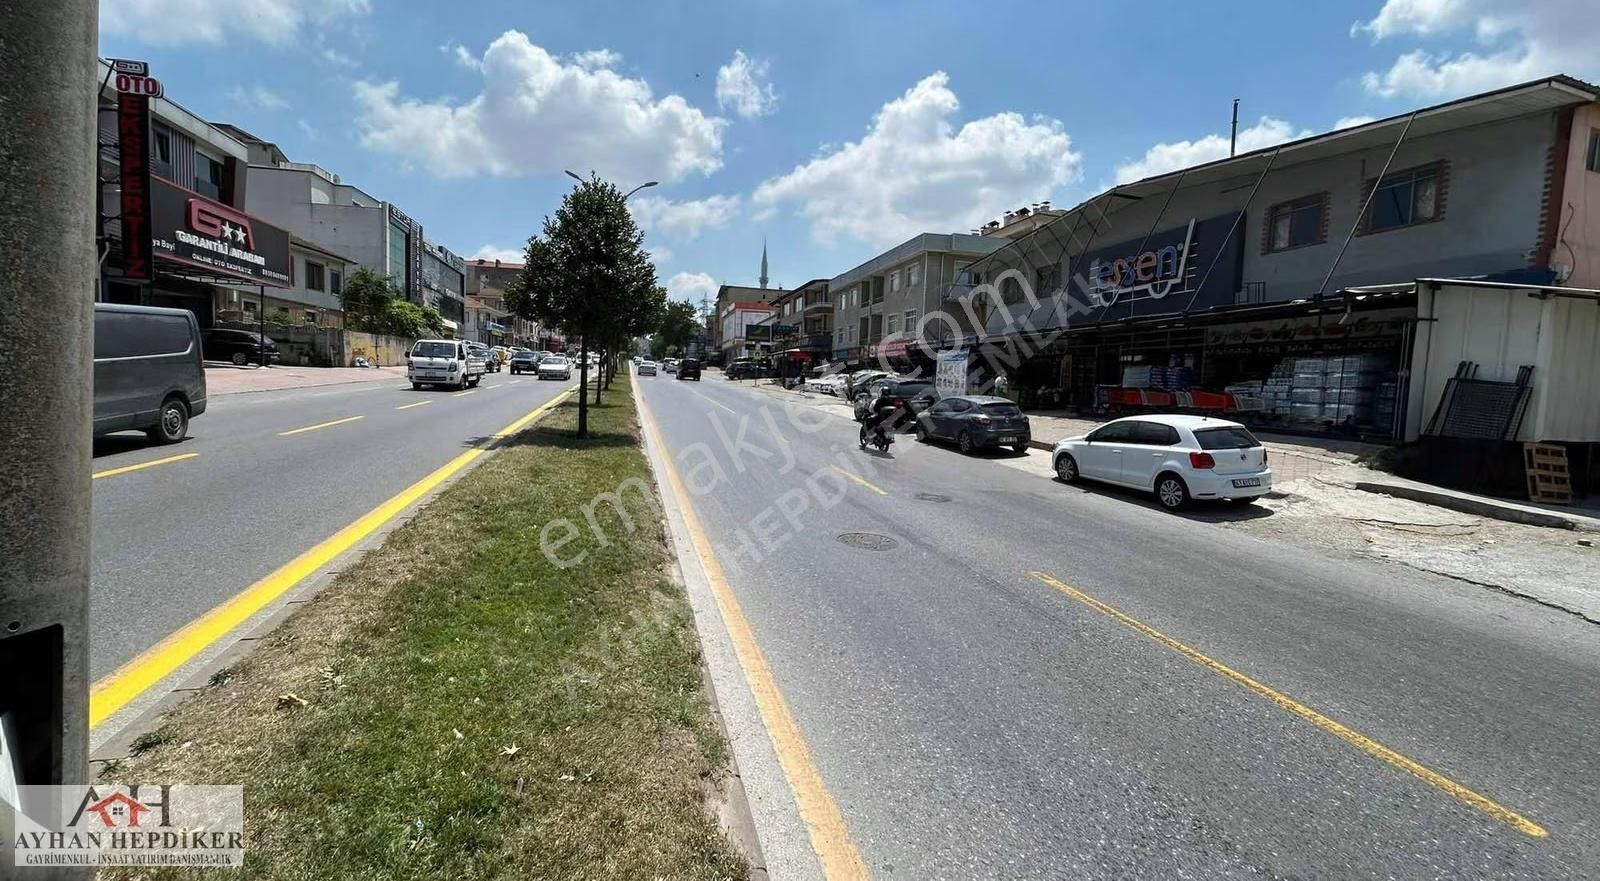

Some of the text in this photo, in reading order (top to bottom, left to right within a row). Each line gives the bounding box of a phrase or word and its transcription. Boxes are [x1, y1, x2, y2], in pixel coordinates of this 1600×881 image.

[116, 74, 160, 96] OTO
[176, 230, 265, 266] GARANTİLİ ARABAM
